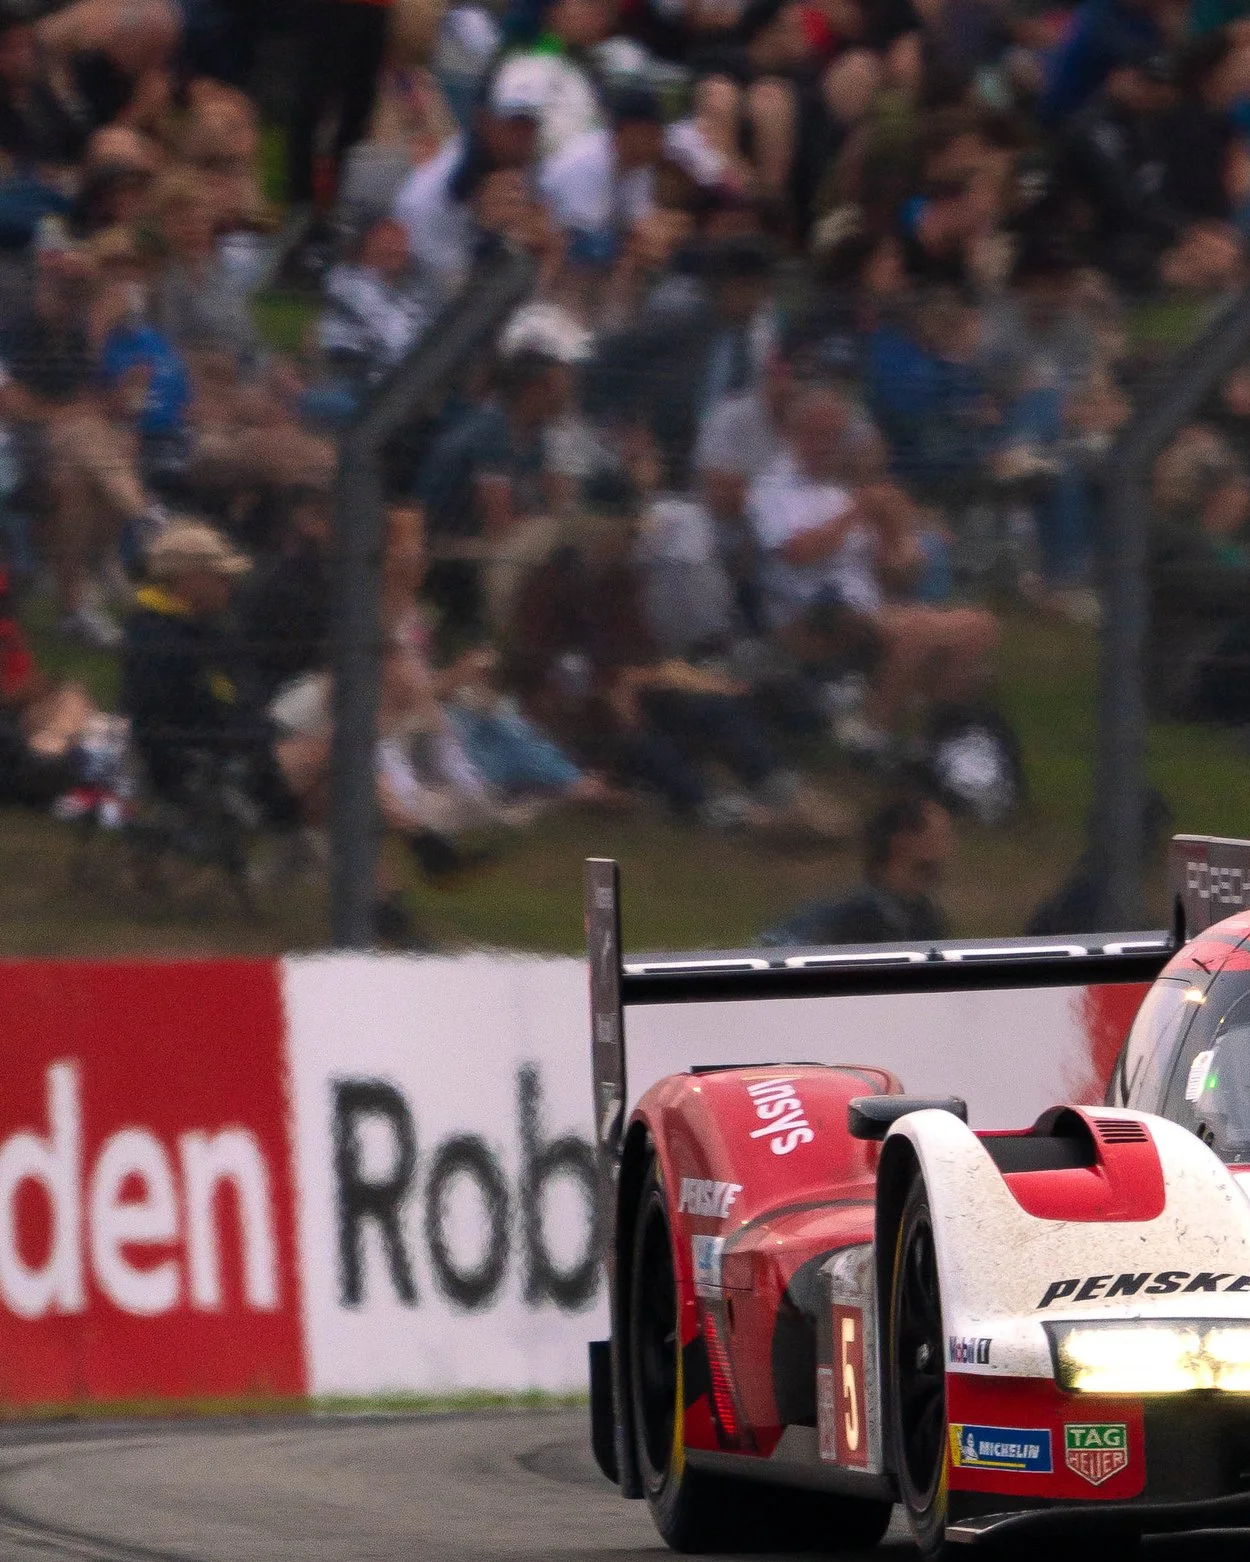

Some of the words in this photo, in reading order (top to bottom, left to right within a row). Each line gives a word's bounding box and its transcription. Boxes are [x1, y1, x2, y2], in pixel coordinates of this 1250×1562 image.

[0, 1058, 282, 1317] den
[330, 1060, 602, 1308] Rob
[841, 1317, 859, 1451] 5
[979, 1441, 1041, 1459] MICHELIN
[1068, 1450, 1125, 1479] HEUER
[1069, 1428, 1121, 1447] TAG
